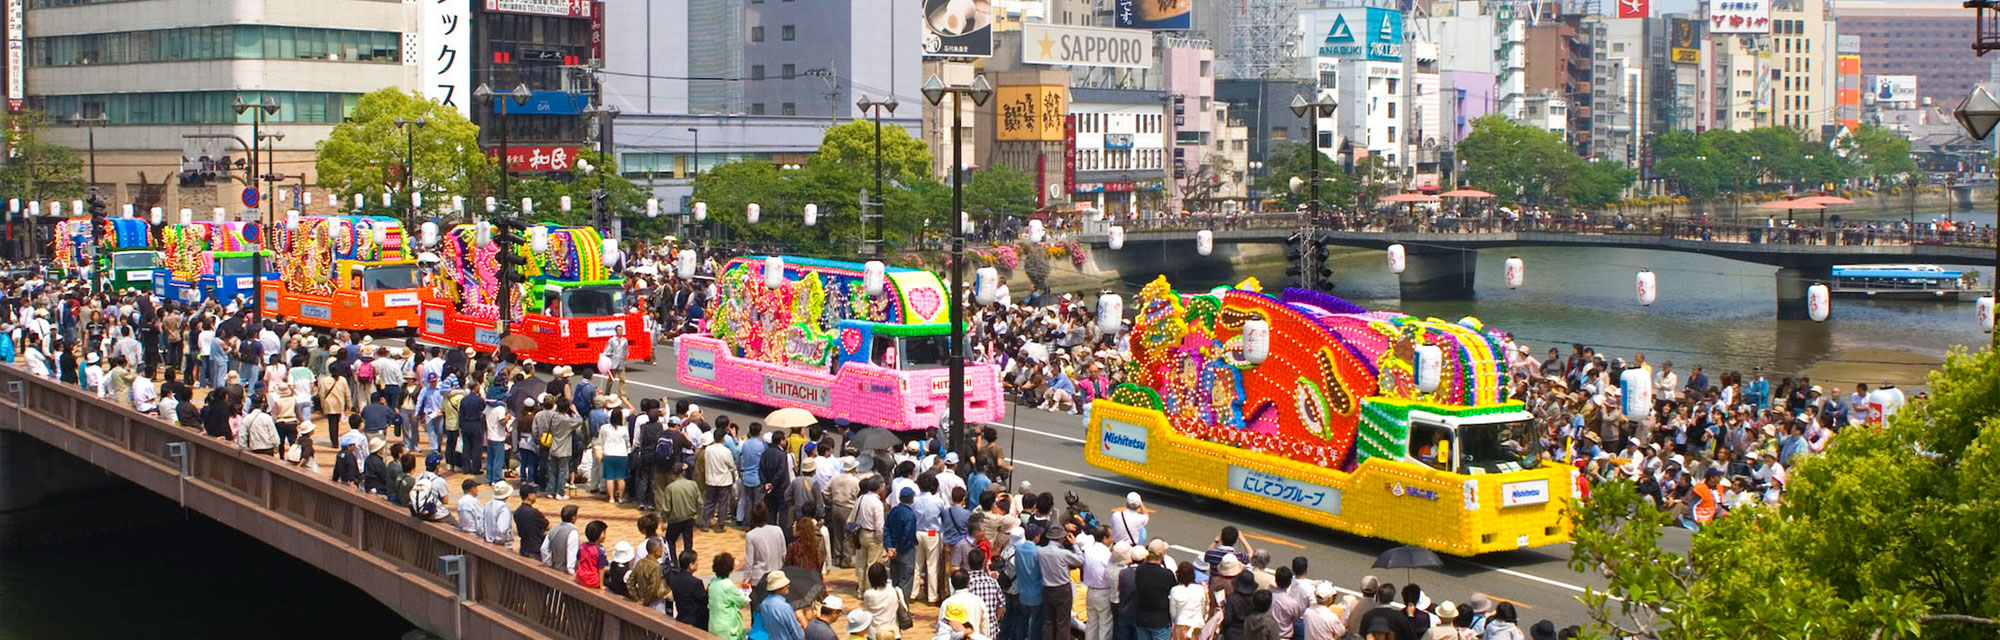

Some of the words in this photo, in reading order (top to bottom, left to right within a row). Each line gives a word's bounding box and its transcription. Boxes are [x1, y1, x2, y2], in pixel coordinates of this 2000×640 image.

[1120, 0, 1132, 25] です。
[437, 0, 458, 110] ックス
[1060, 34, 1142, 64] SAPPORO
[1319, 46, 1362, 56] ANABUKI
[529, 147, 568, 170] 和民
[775, 381, 818, 402] HITACHI
[1104, 431, 1146, 451] Nishitetsu
[1243, 476, 1326, 506] にしてつグループ
